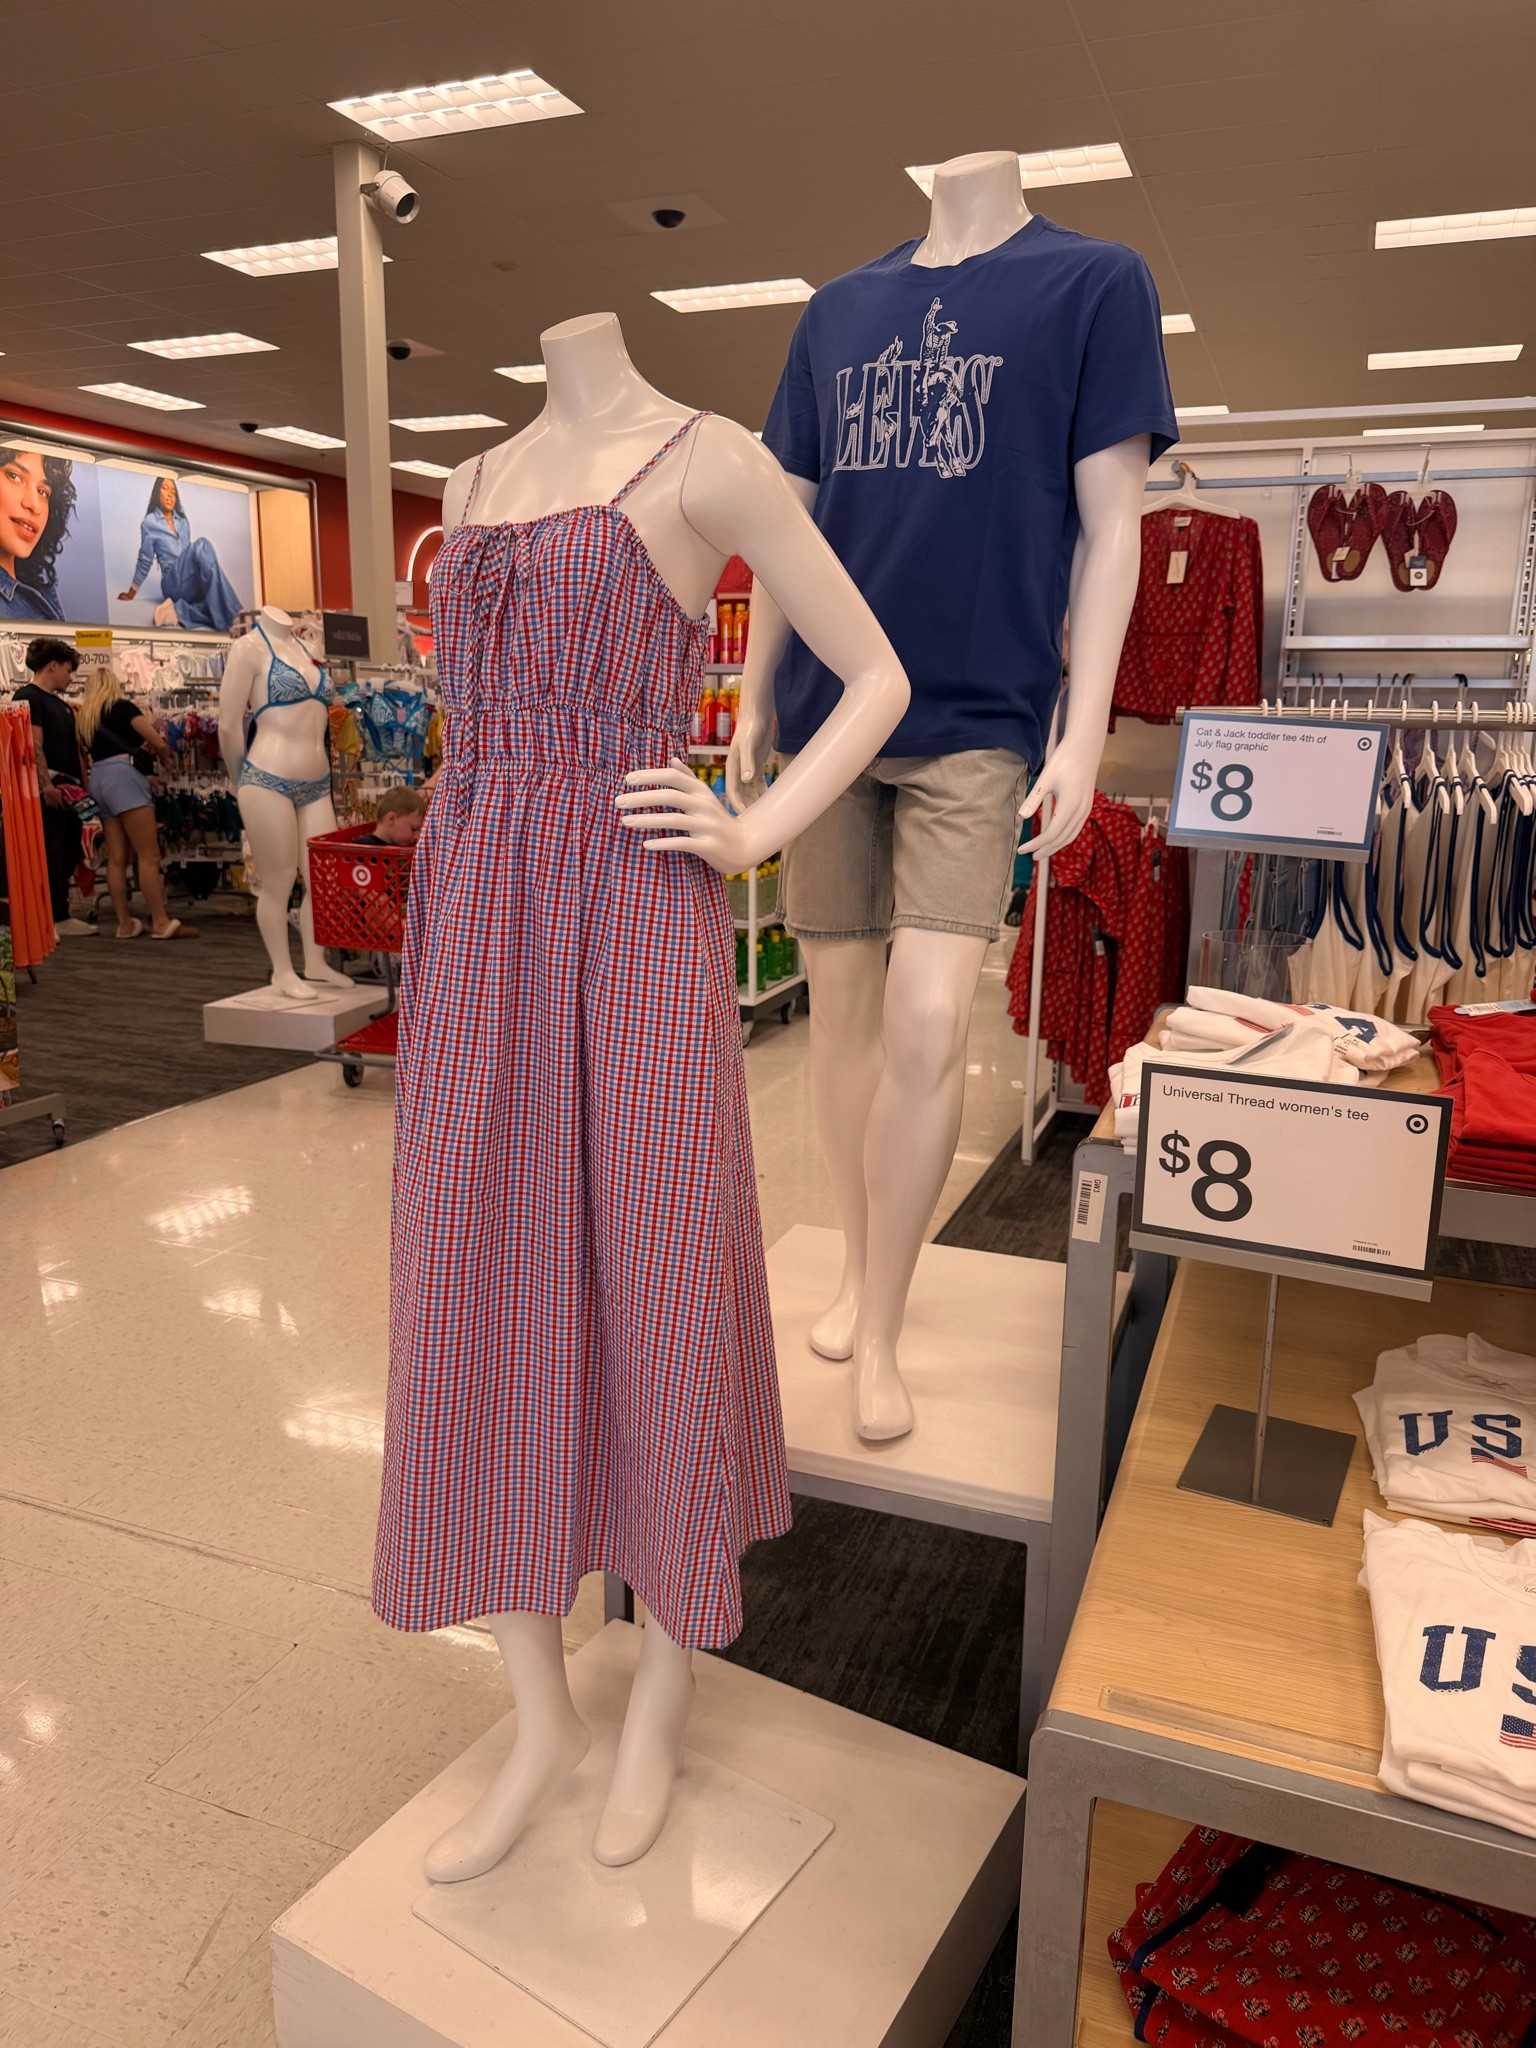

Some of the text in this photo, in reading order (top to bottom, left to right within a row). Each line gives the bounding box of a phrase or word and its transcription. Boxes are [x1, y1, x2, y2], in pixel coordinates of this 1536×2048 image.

[1195, 739, 1269, 753] July flag graphic
[1196, 727, 1327, 744] Cat & Jack toddler tee 4th of
[1190, 759, 1254, 822] $8
[1162, 1085, 1370, 1121] Universal Thread women's tee
[1158, 1129, 1253, 1222] $8
